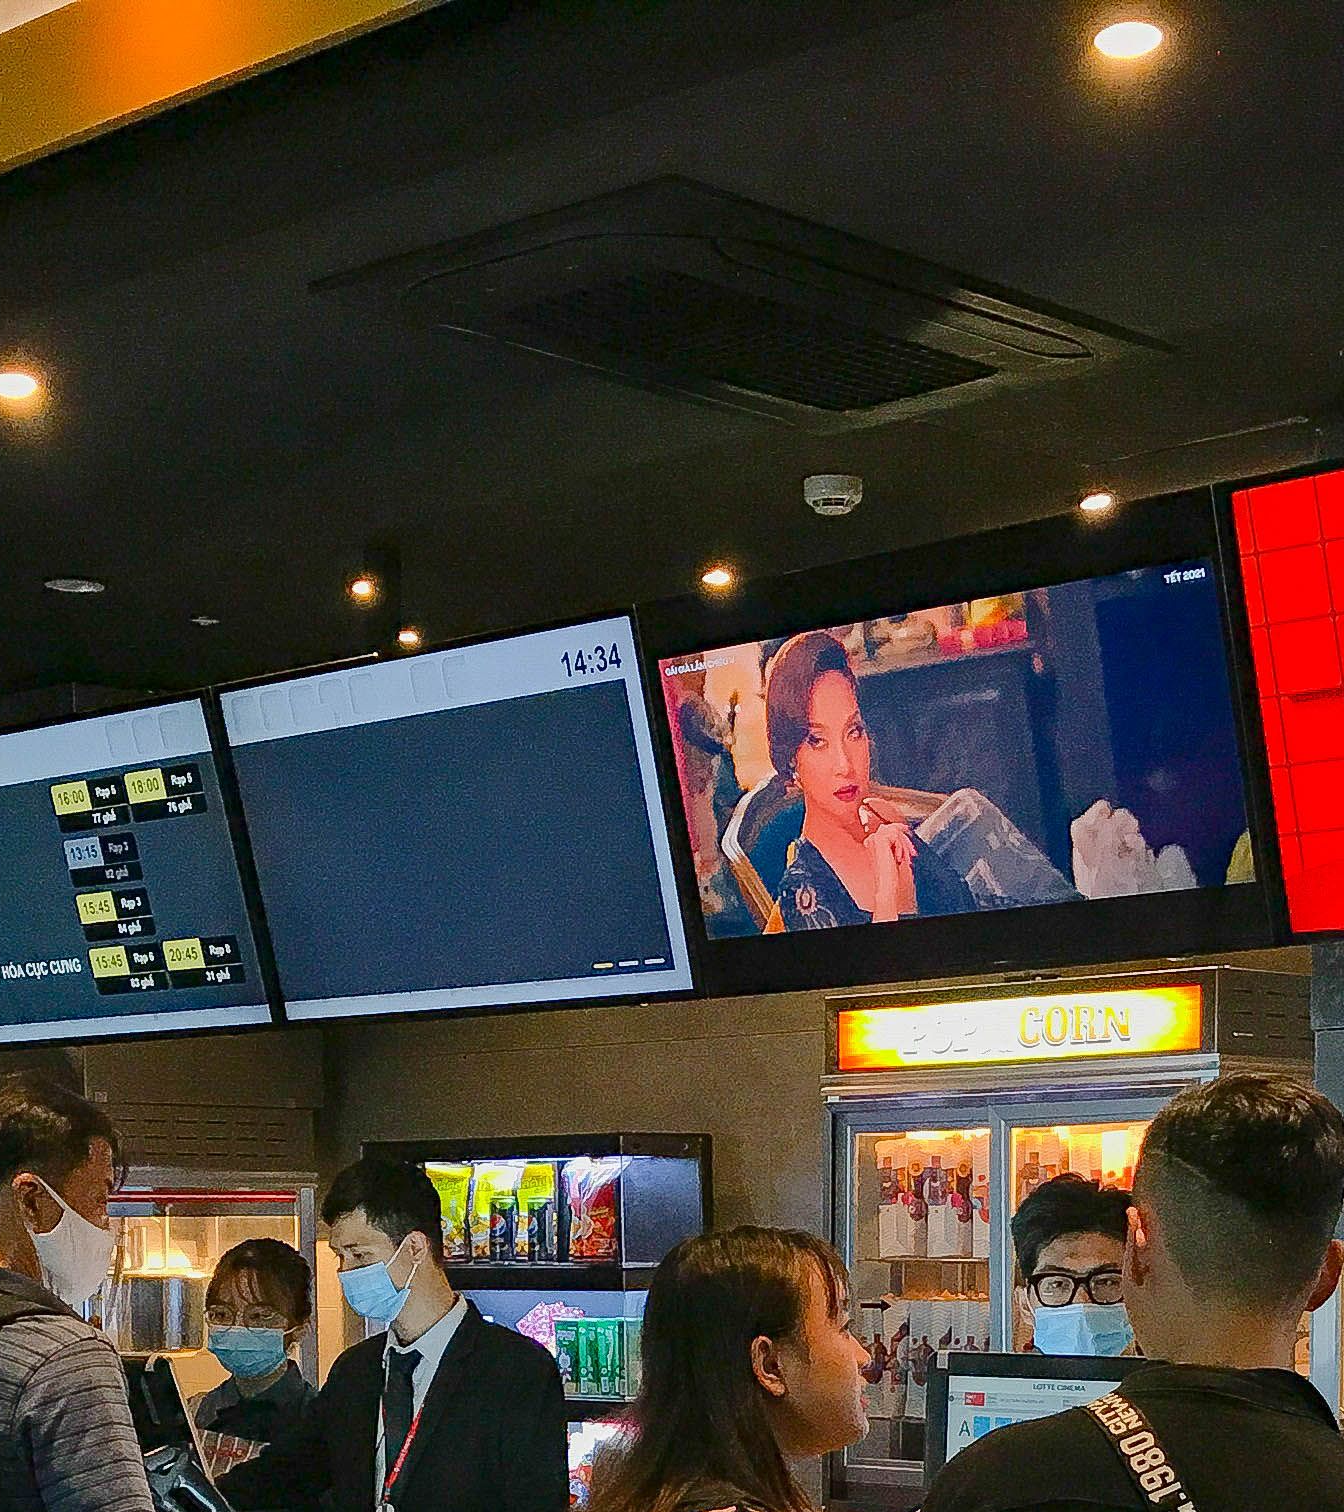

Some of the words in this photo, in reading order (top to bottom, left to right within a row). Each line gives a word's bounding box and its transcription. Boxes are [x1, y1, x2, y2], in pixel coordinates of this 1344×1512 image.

[560, 642, 622, 678] 14:34
[57, 789, 85, 806] 16:00
[83, 900, 110, 915] 15:45
[95, 954, 123, 969] 15:45
[169, 947, 198, 962] 20:45
[1018, 1006, 1131, 1048] CORN
